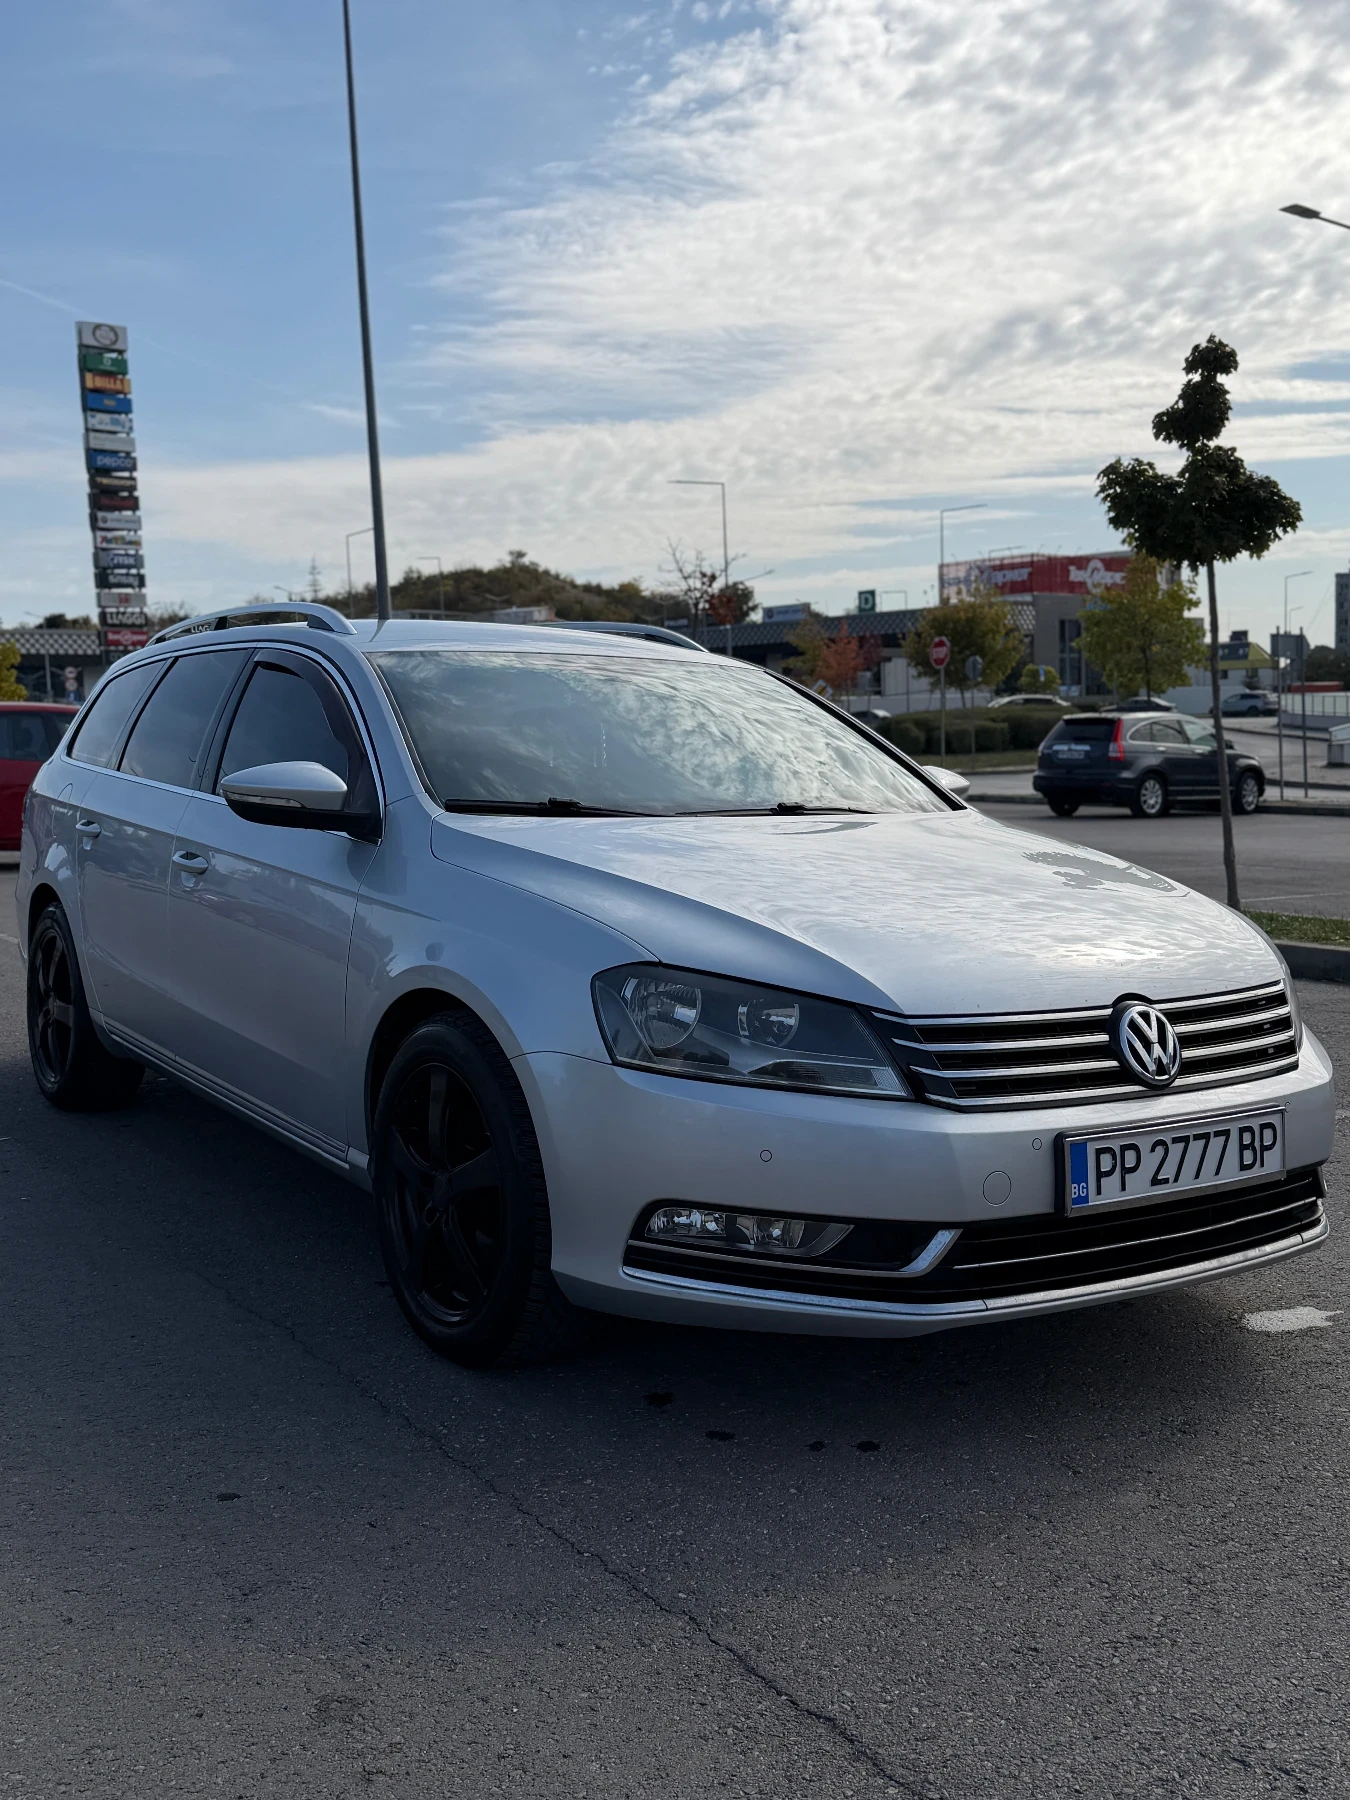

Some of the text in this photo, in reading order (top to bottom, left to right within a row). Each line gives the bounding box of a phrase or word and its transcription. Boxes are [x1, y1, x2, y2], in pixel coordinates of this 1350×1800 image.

[97, 455, 133, 468] pepco
[1095, 1121, 1278, 1196] PP 2777 BP
[1071, 1183, 1087, 1198] BG
